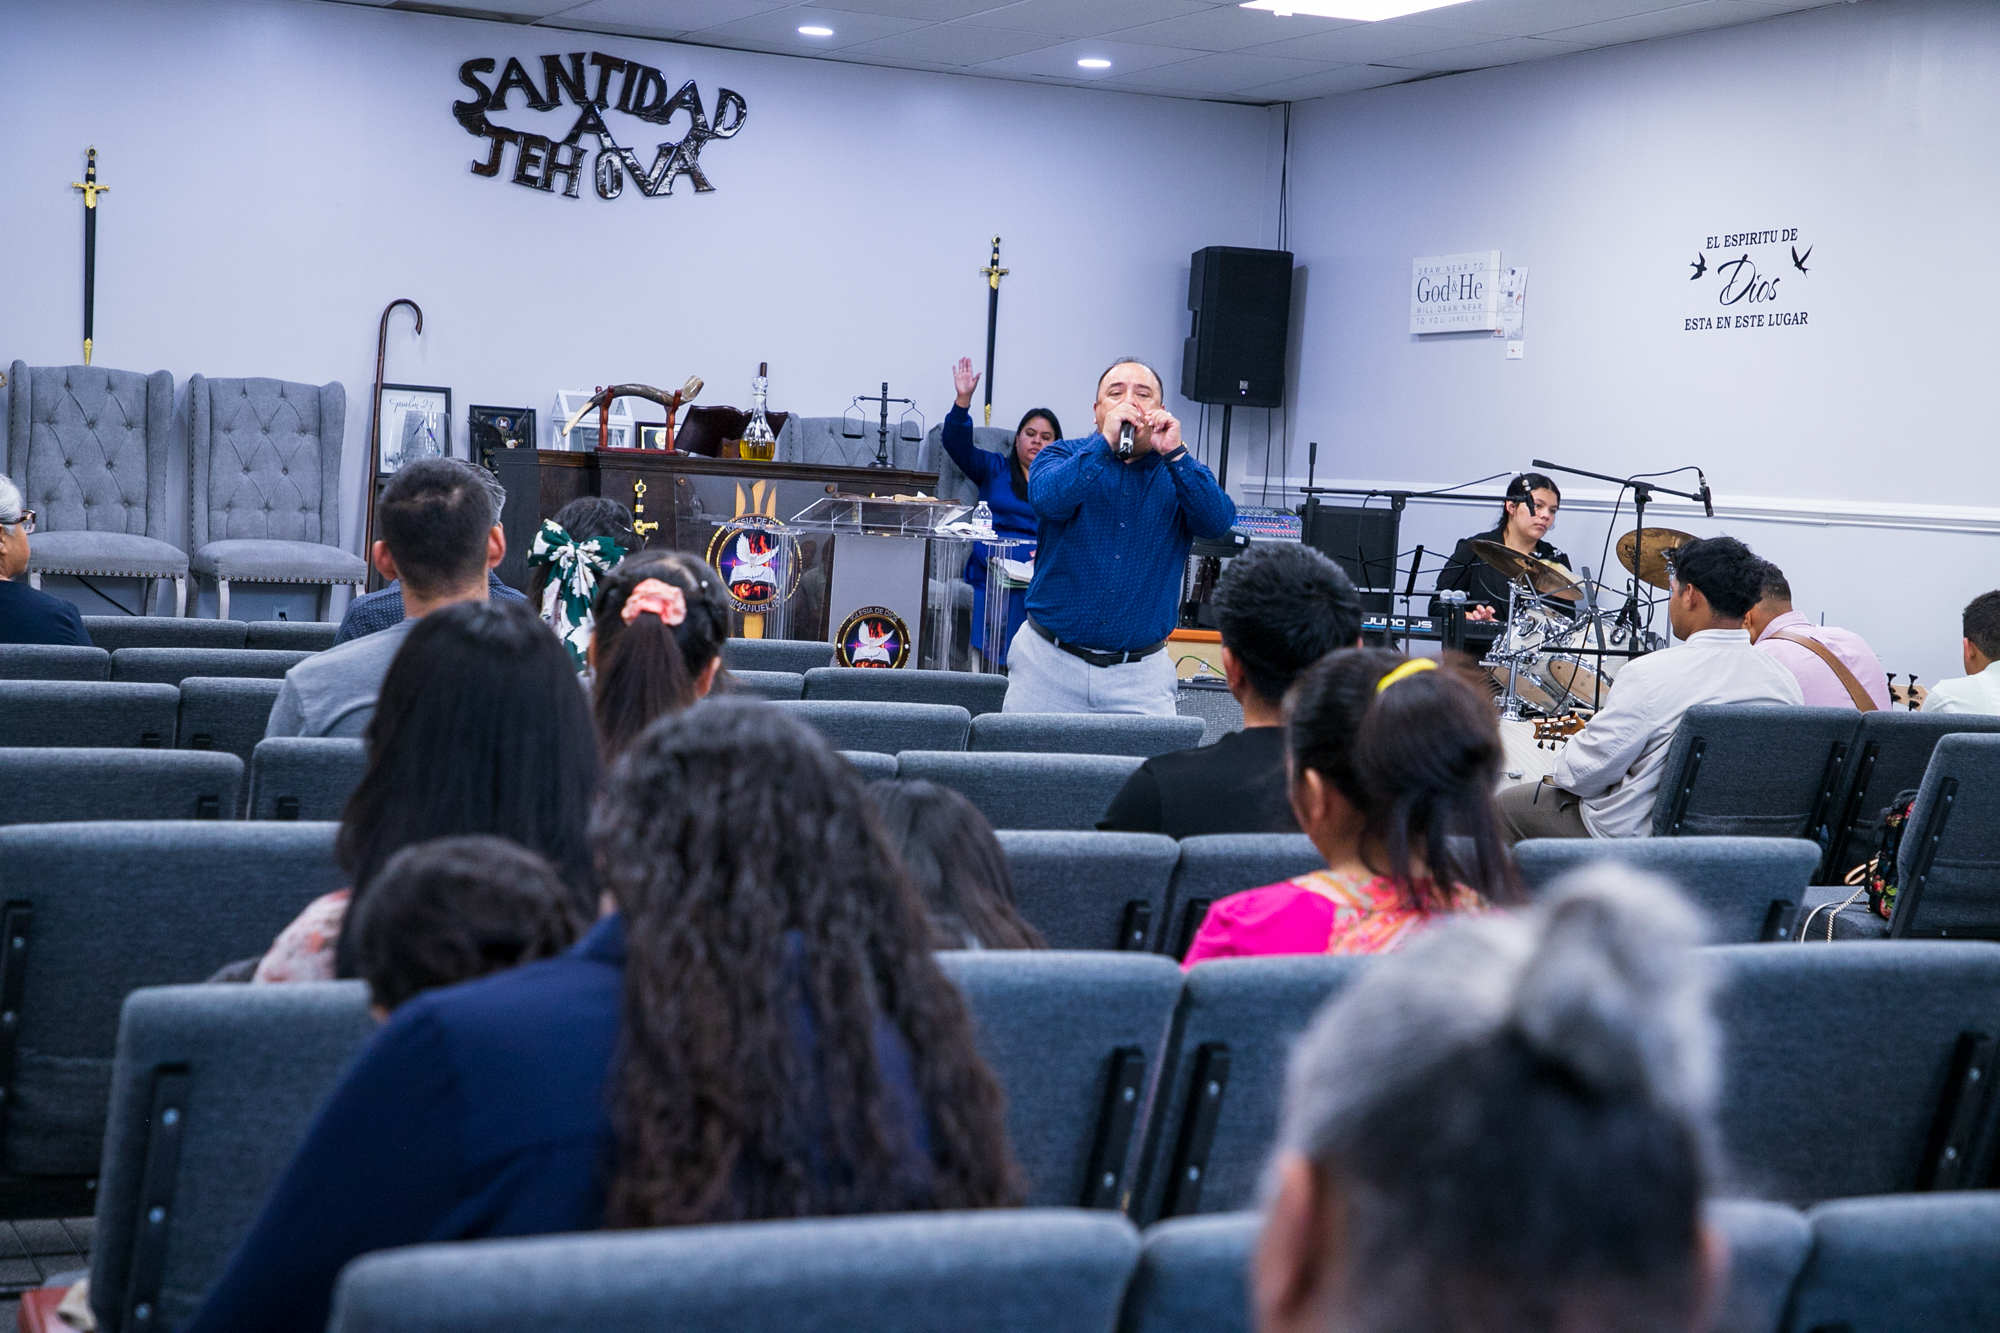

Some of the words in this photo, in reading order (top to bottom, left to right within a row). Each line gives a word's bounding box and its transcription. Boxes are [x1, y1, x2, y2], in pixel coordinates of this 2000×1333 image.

[452, 51, 747, 139] SANTIDAD
[470, 127, 717, 199] JEHOVA
[1706, 236, 1721, 250] EL
[1723, 229, 1779, 248] ESPIRITU
[1781, 227, 1799, 242] DE
[1418, 266, 1441, 275] DRAW
[1446, 263, 1468, 273] NEAR
[1473, 262, 1484, 270] TO
[1417, 275, 1451, 304] God
[1451, 280, 1458, 293] &
[1458, 273, 1483, 301] He
[1717, 253, 1781, 306] Dios
[1416, 306, 1433, 314] WILL
[1437, 304, 1458, 313] DRAW
[1462, 302, 1483, 311] NEAR
[1416, 317, 1425, 325] TO
[1684, 317, 1713, 331] ESTA
[1716, 315, 1732, 329] EN
[1735, 314, 1765, 328] ESTE
[1768, 311, 1809, 327] LUGAR
[420, 399, 434, 411] 23
[850, 607, 874, 622] IGLESIA
[874, 607, 885, 615] DE
[884, 609, 899, 623] DIOS
